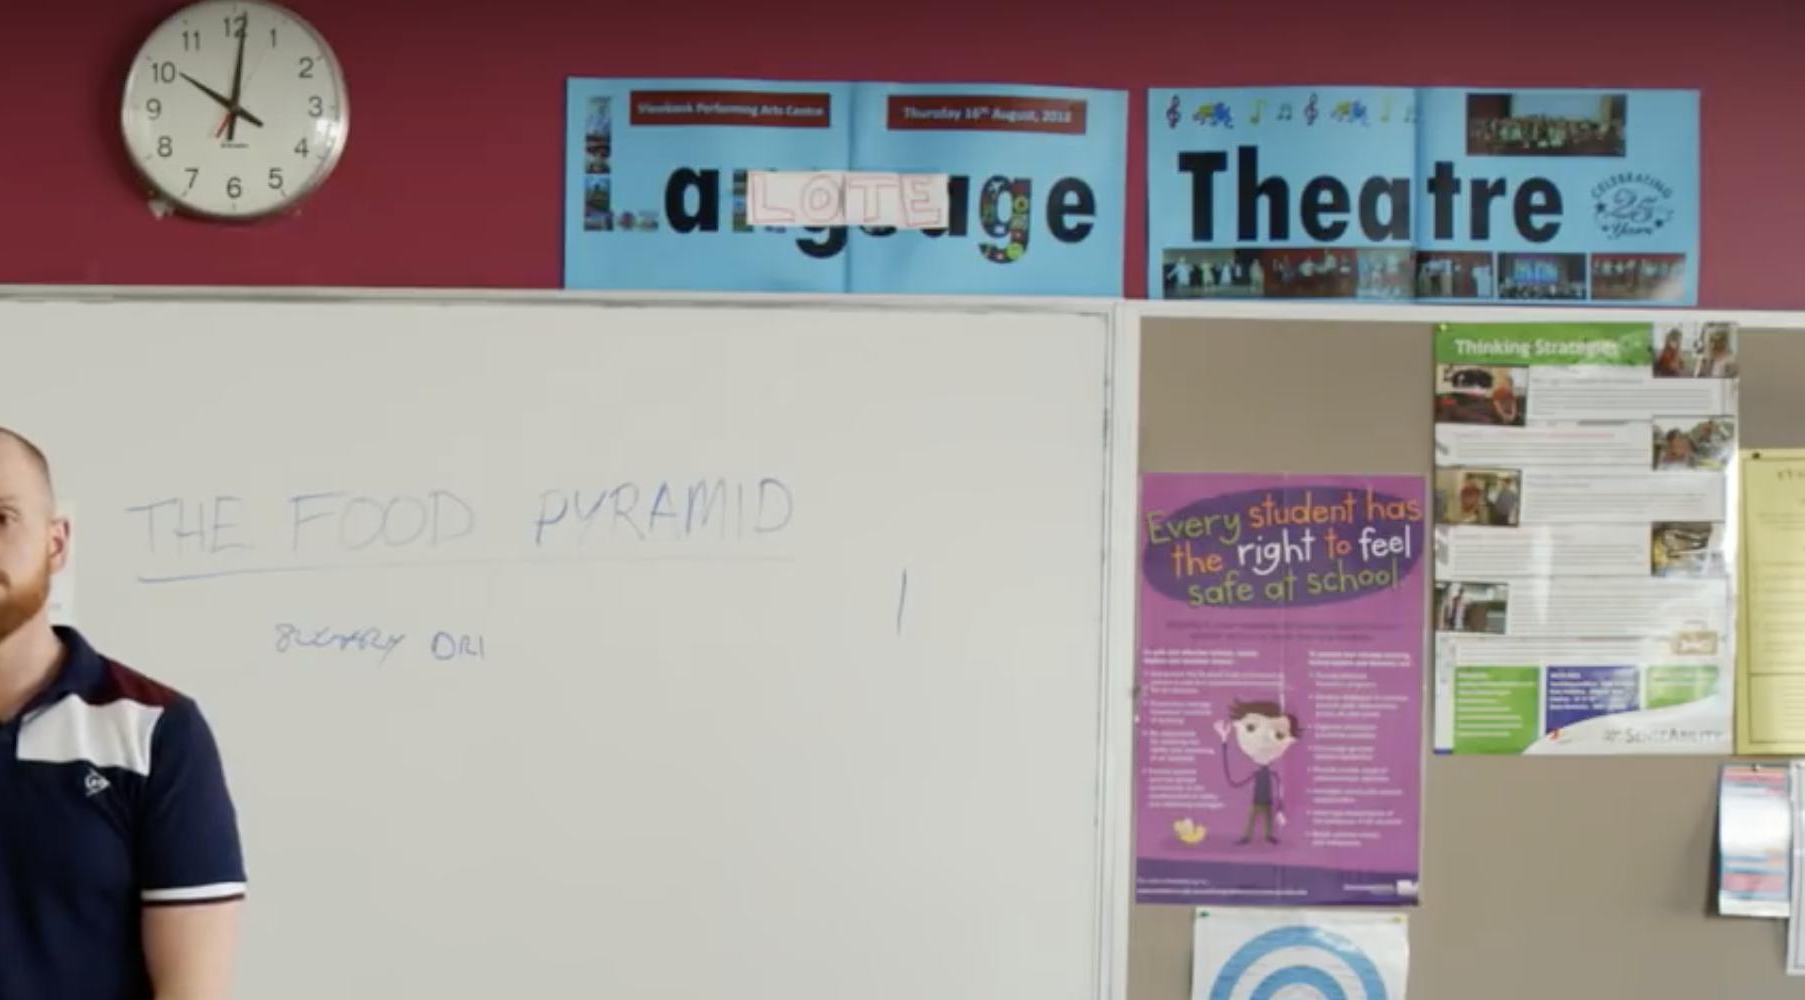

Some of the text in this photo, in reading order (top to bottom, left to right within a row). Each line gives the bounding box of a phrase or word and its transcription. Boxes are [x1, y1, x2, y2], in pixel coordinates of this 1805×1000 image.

[223, 16, 247, 38] 12
[270, 28, 277, 48] 1
[182, 30, 200, 50] 11
[152, 61, 176, 83] 10
[299, 56, 314, 78] 2
[146, 98, 161, 120] 9
[308, 96, 323, 117] 3
[904, 106, 961, 122] Thursday
[157, 136, 173, 158] 8
[294, 138, 309, 157] 4
[184, 168, 199, 189] 7
[227, 177, 241, 198] 6
[268, 168, 283, 189] 5
[751, 173, 942, 227] LOTE
[1178, 145, 1564, 243] Theatre
[1455, 339, 1531, 358] Thinking
[127, 478, 795, 557] THE FOOD PYRAMID
[1146, 485, 1424, 545] Every student has
[1171, 541, 1224, 579] the
[1237, 528, 1316, 576] right
[1324, 527, 1352, 560] to
[1359, 524, 1411, 561] feel
[1188, 569, 1255, 606] safe
[1264, 566, 1298, 602] at
